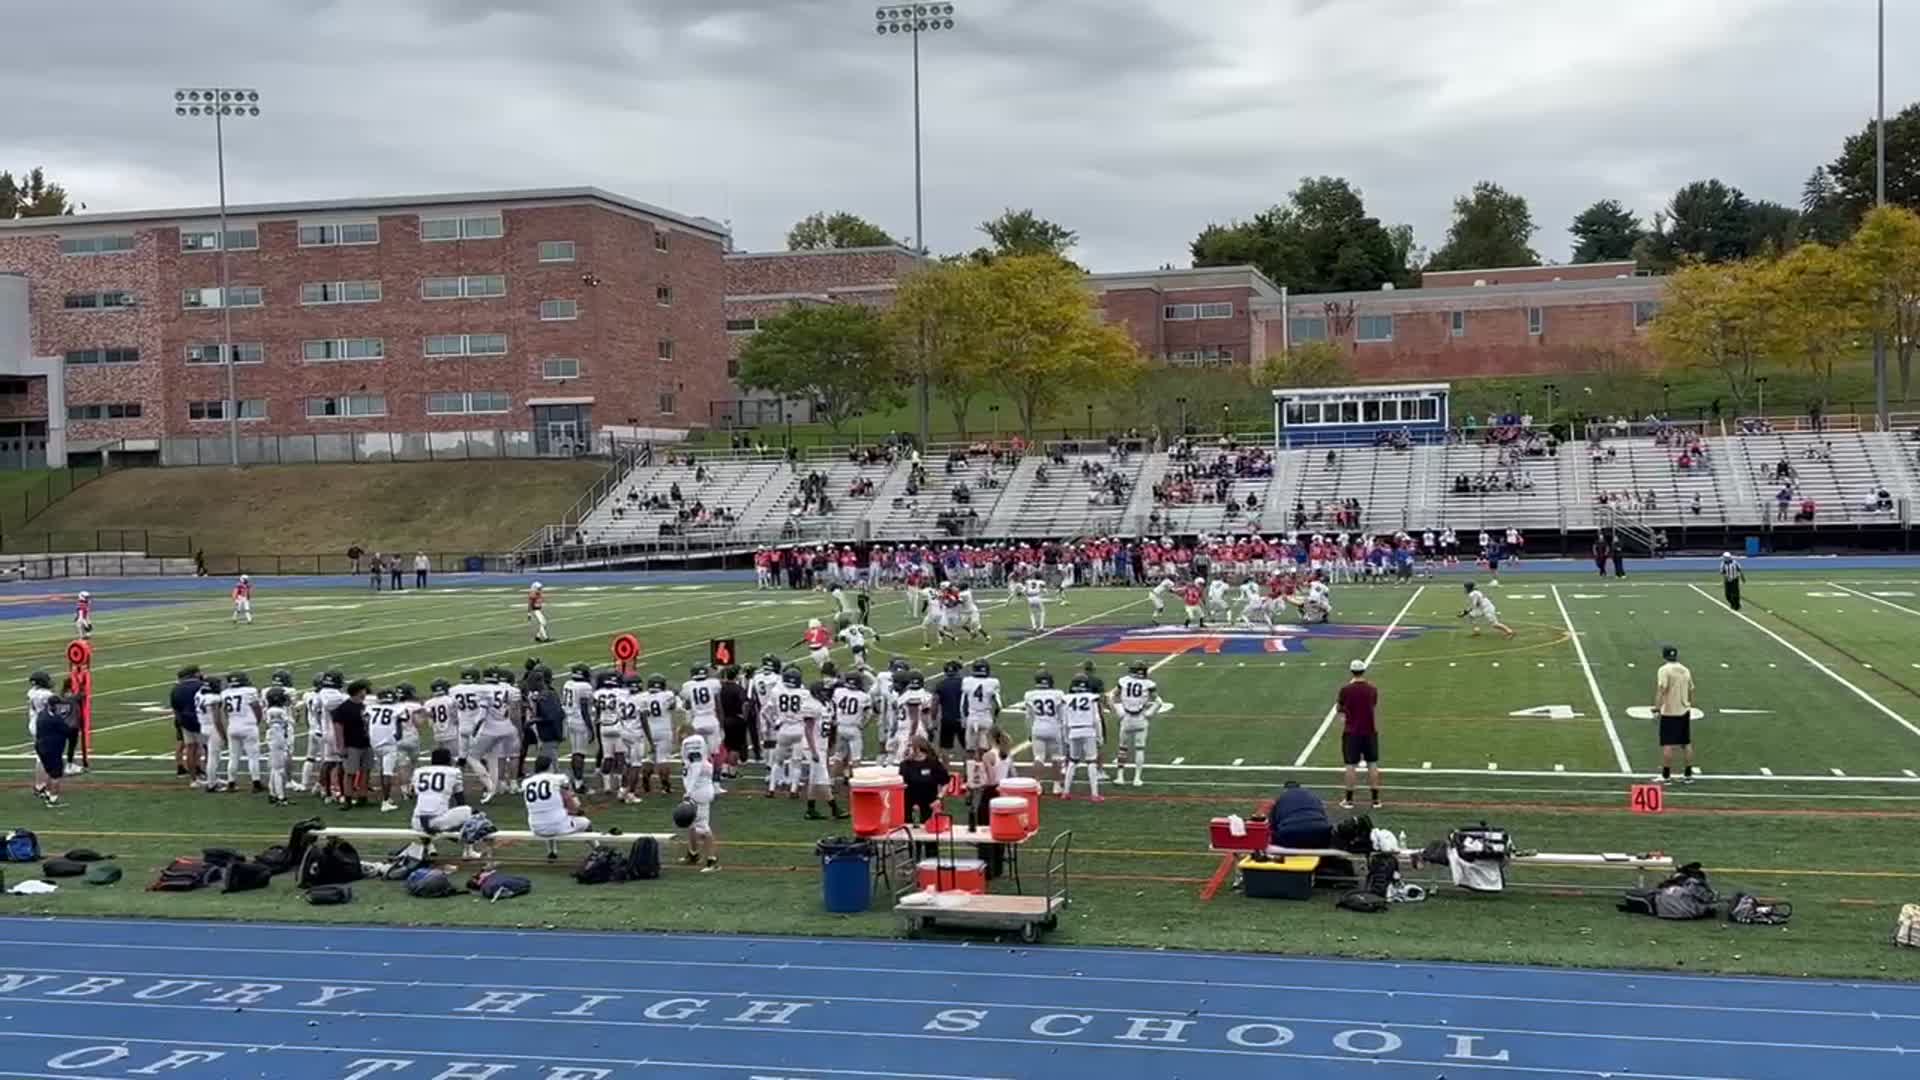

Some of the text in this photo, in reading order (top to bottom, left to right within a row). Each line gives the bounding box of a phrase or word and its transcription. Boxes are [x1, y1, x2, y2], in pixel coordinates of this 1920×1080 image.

[692, 687, 711, 705] 18
[973, 684, 985, 702] 4
[1125, 682, 1143, 698] 10
[223, 695, 242, 712] 67
[455, 693, 478, 711] 35
[618, 701, 637, 720] 32
[778, 694, 802, 713] 88
[838, 696, 858, 715] 40
[1033, 699, 1056, 717] 33
[1068, 697, 1091, 711] 42
[371, 707, 394, 725] 78
[417, 772, 447, 792] 50
[525, 780, 553, 803] 60
[1634, 787, 1660, 810] 40
[452, 991, 814, 1024] HIGH
[922, 1008, 1510, 1061] SCHOOL
[47, 1045, 226, 1074] OF
